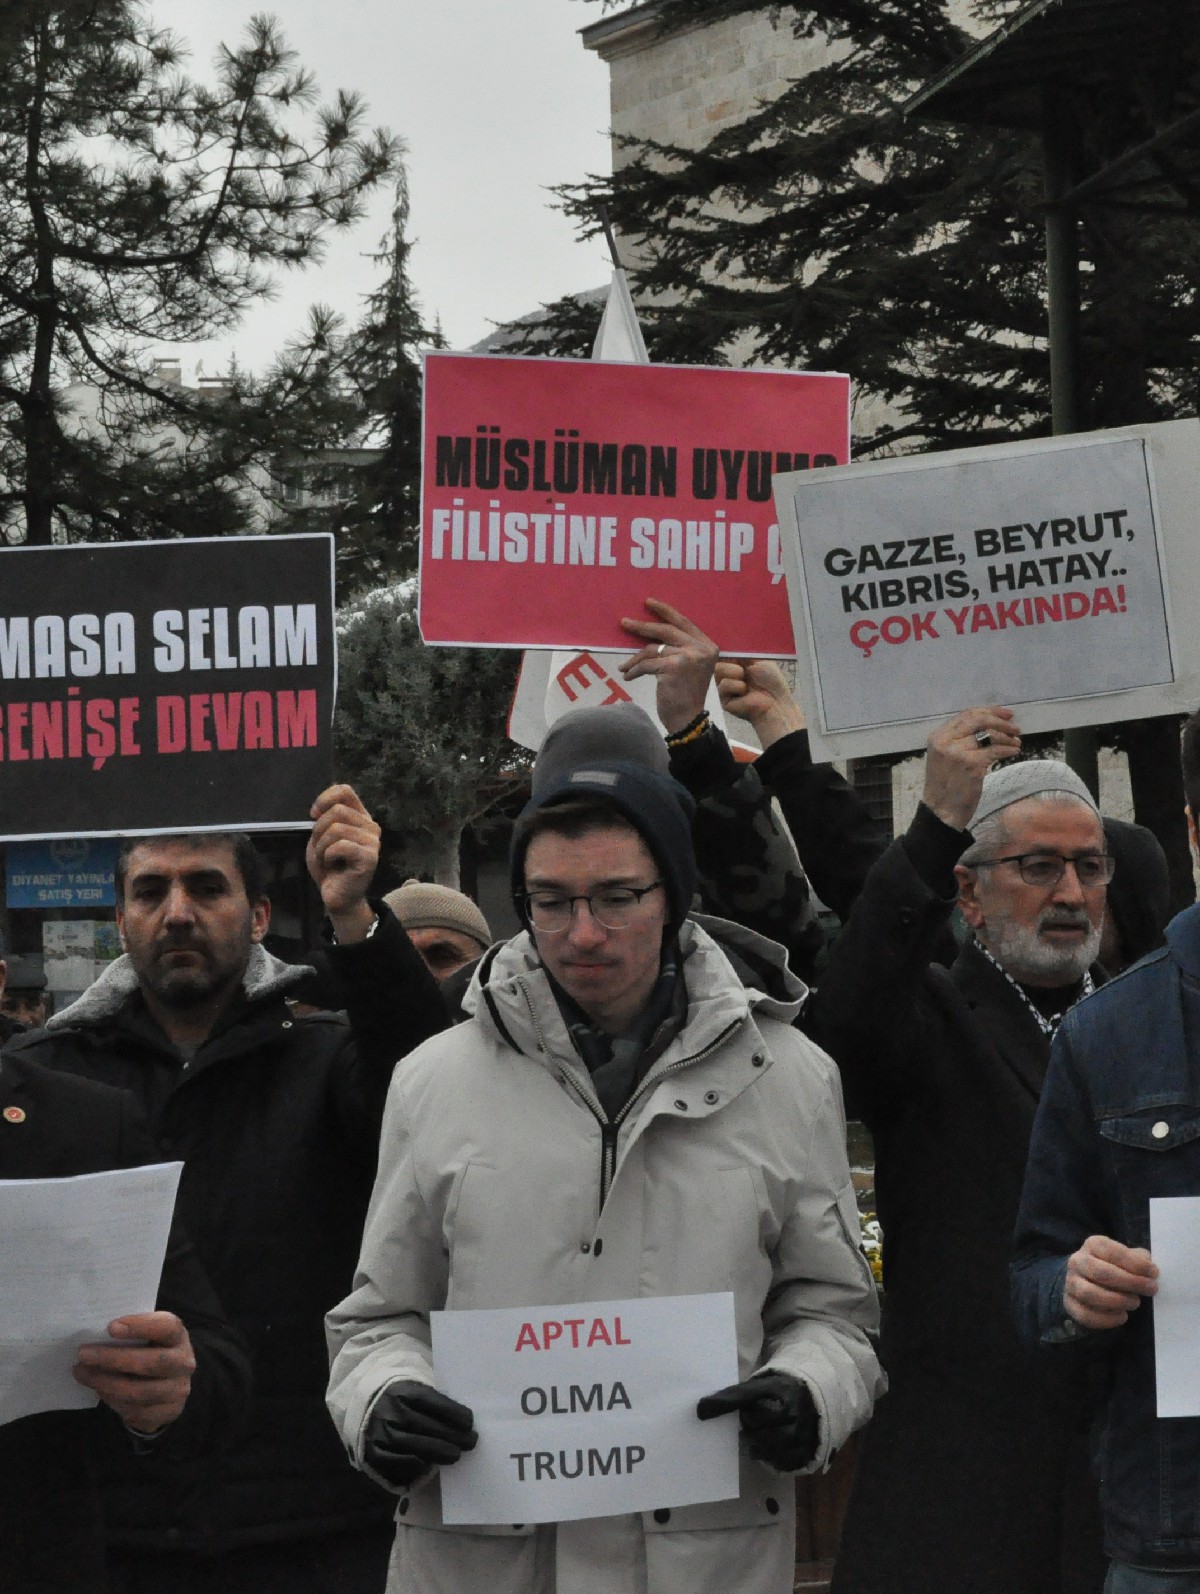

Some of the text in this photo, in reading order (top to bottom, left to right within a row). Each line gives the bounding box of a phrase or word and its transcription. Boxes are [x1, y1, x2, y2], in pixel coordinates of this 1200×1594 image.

[435, 424, 678, 498] MÜSLÜMAN
[431, 498, 617, 567] FİLİSTİNE
[630, 510, 754, 572] SAHİP
[823, 509, 1135, 577] GAZZE, BEYRUT,
[840, 549, 1128, 613] KIBRIS, HATAY..
[153, 604, 318, 672] SELAM
[849, 584, 1127, 658] ÇOK YAKINDA!
[0, 687, 318, 771] ENİŞE DEVAM
[515, 1317, 632, 1352] APTAL
[520, 1381, 632, 1416] OLMA
[510, 1445, 646, 1482] TRUMP
